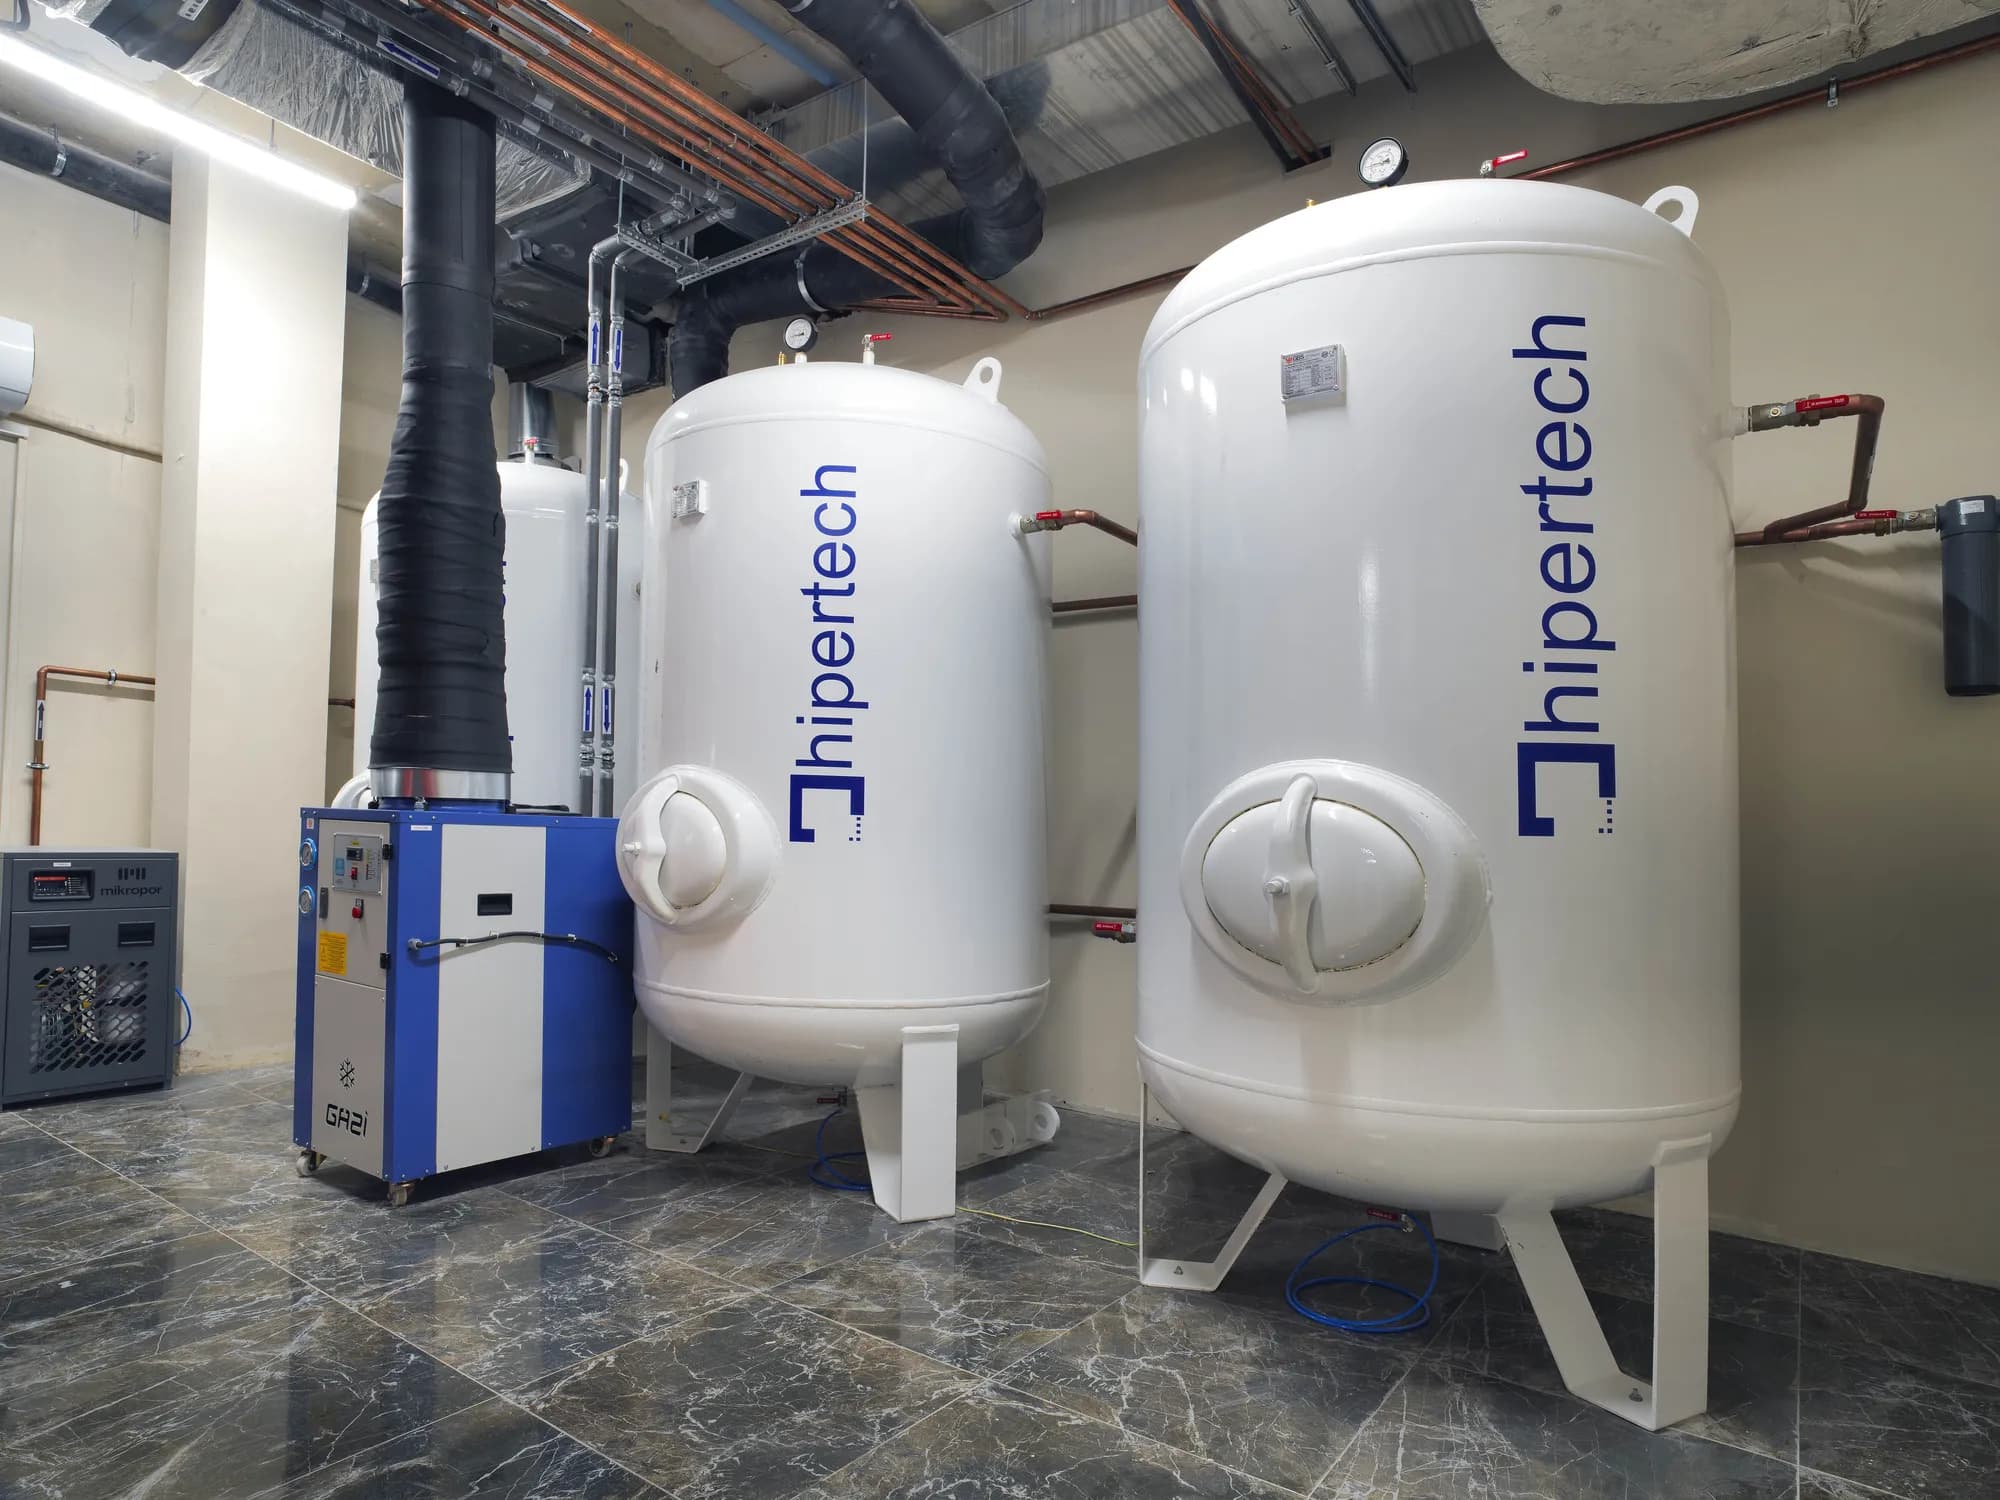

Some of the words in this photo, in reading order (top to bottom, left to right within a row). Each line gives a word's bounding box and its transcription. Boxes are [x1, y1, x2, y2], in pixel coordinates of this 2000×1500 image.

[796, 465, 868, 768] hipertech
[1512, 314, 1616, 732] hipertech
[100, 885, 162, 897] mikropor
